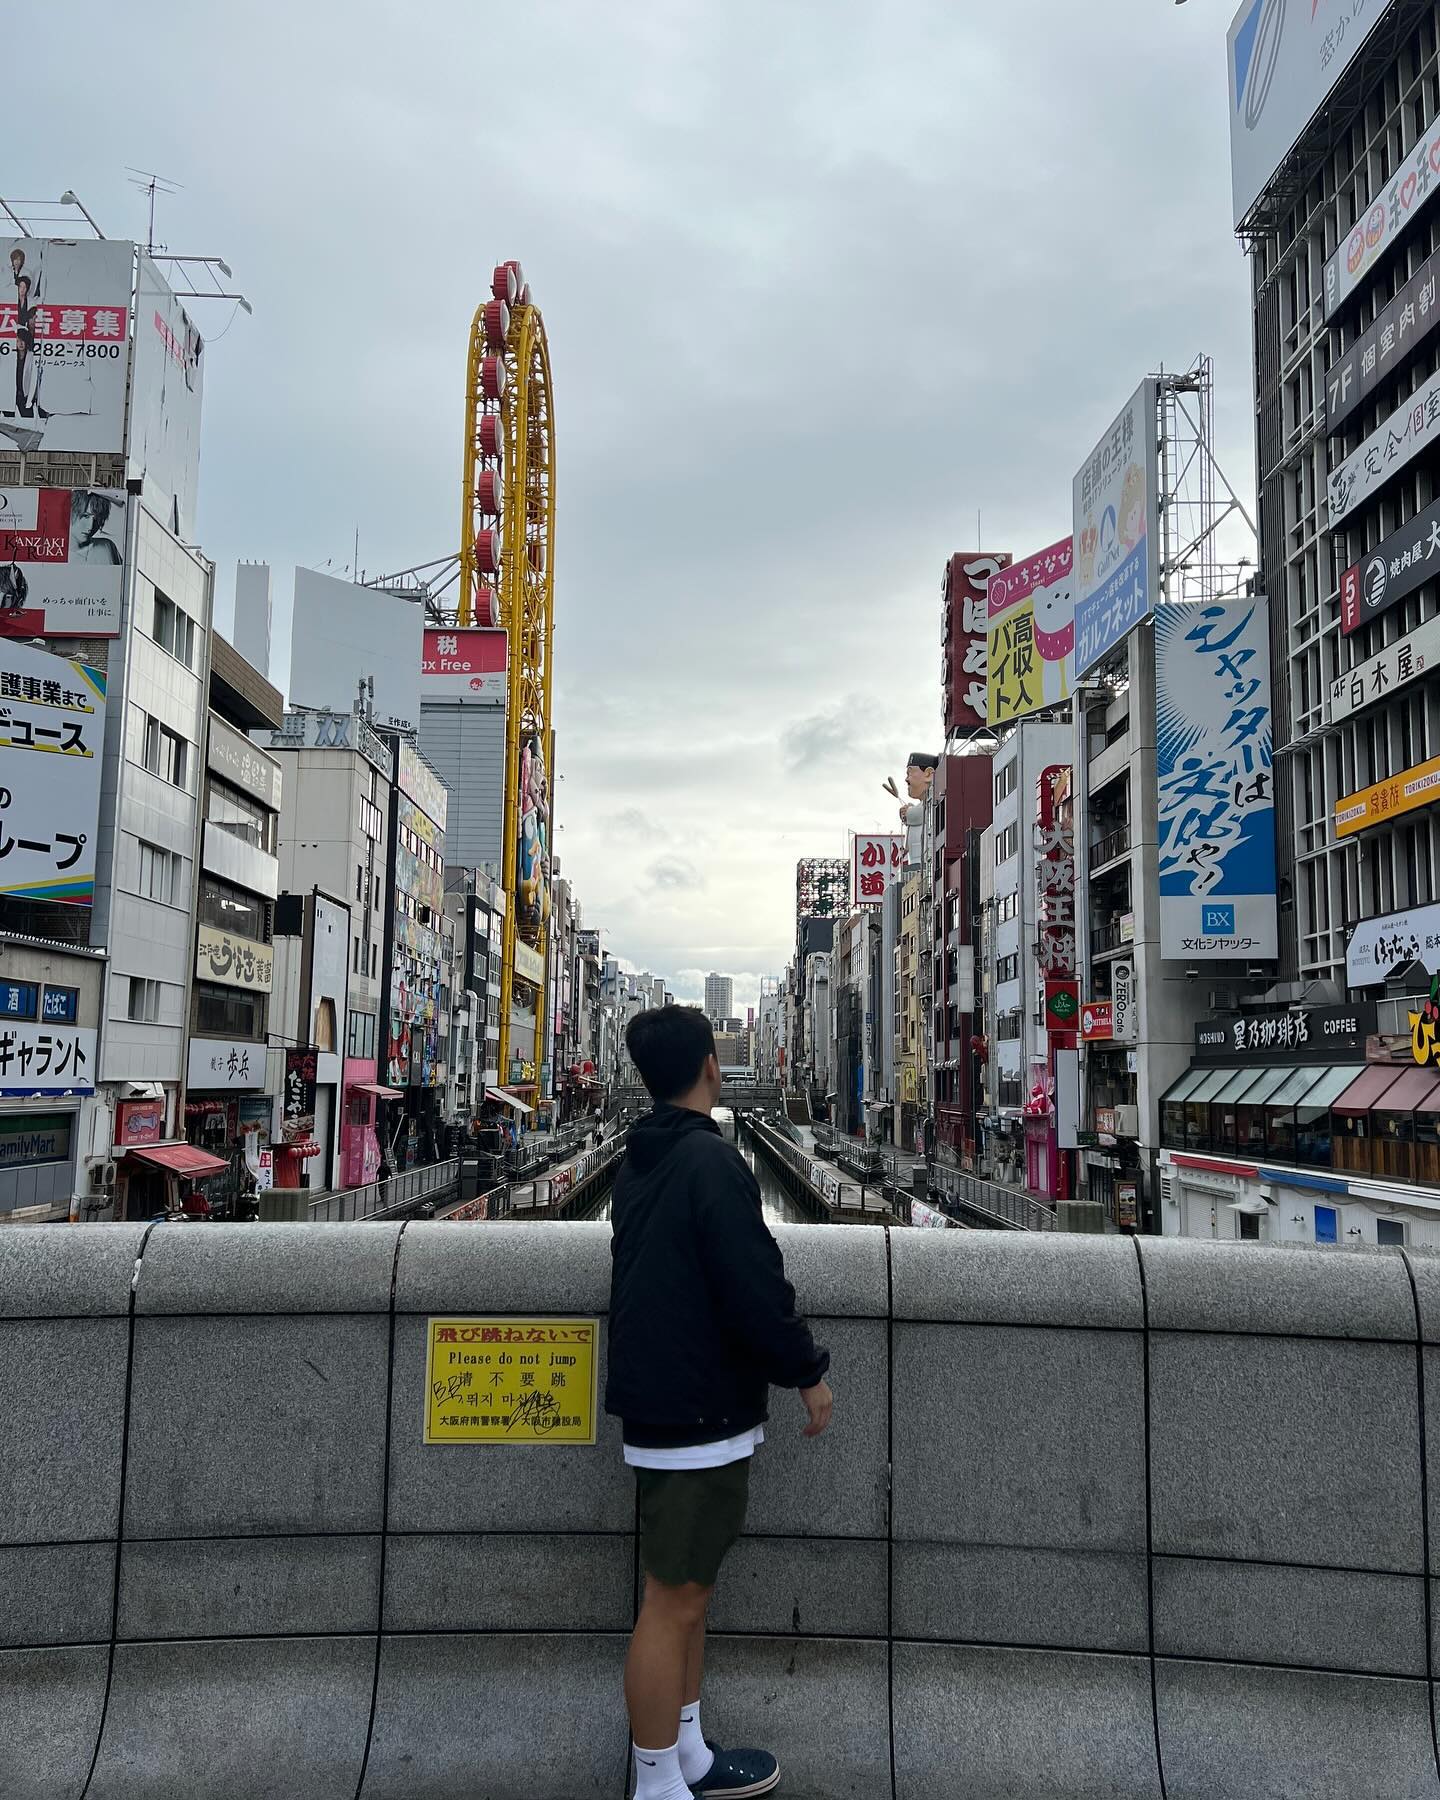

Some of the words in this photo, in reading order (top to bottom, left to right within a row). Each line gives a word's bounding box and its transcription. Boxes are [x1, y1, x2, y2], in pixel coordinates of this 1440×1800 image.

[1326, 263, 1336, 311] 8F
[0, 308, 120, 337] 広告募集
[0, 342, 120, 359] 6-282-7800
[1328, 363, 1353, 415] 7F
[4, 534, 65, 551] KANZAKI
[1007, 545, 1072, 591] いちごなび
[1389, 539, 1423, 579] 焼肉屋
[1345, 573, 1355, 626] 5F
[1078, 577, 1144, 665] ガルフネット
[437, 635, 458, 656] 税
[440, 658, 472, 671] Free
[991, 620, 1012, 719] バイト
[1012, 611, 1034, 712] 高収入
[1333, 678, 1346, 700] 4F
[1350, 643, 1415, 709] 白木屋
[1038, 820, 1075, 972] 大阪王将
[1206, 911, 1232, 927] BX
[7, 987, 20, 1011] 酒
[43, 992, 67, 1015] たばこ
[1116, 981, 1127, 1011] ZERO
[1233, 1011, 1309, 1051] 星乃珈琲店
[1323, 1017, 1357, 1035] COFFEE
[226, 1048, 250, 1081] 歩兵
[0, 1134, 56, 1157] amilyMart
[436, 1327, 592, 1343] 飛び跳ねないで
[449, 1352, 492, 1365] Please
[499, 1352, 513, 1365] do
[519, 1353, 540, 1365] not
[549, 1352, 577, 1367] jump
